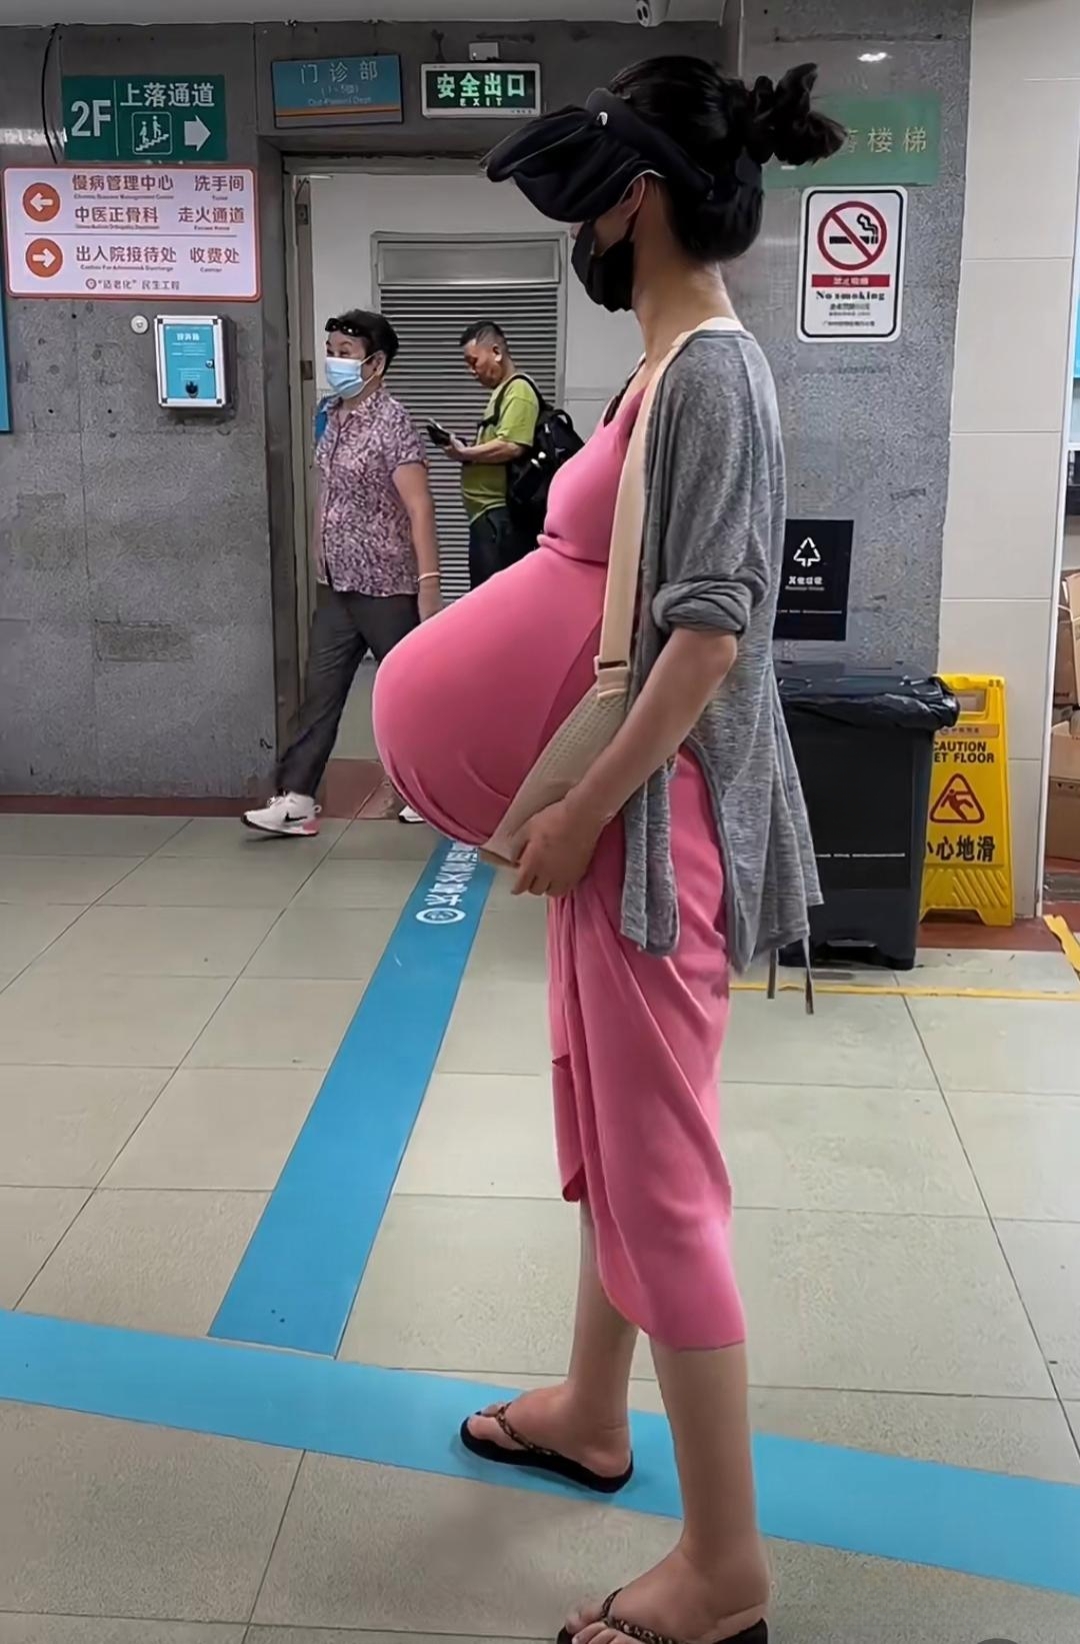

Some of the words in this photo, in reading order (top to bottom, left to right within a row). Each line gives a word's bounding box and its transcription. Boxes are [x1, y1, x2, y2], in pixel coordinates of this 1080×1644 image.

[300, 60, 378, 84] 门诊部
[436, 72, 525, 99] 安全出口
[120, 82, 215, 107] 上落通道
[459, 97, 502, 107] EXIT
[71, 100, 112, 137] 2F
[72, 174, 174, 191] 慢病管理中心
[194, 175, 244, 192] 洗手间
[75, 206, 159, 223] 中医正骨科
[178, 206, 245, 223] 走火通道
[76, 246, 177, 263] 出入院接待处
[190, 247, 239, 264] 收费处
[816, 290, 832, 300] No
[835, 290, 886, 301] smoking
[933, 752, 948, 763] ET
[954, 752, 995, 763] FLOOR
